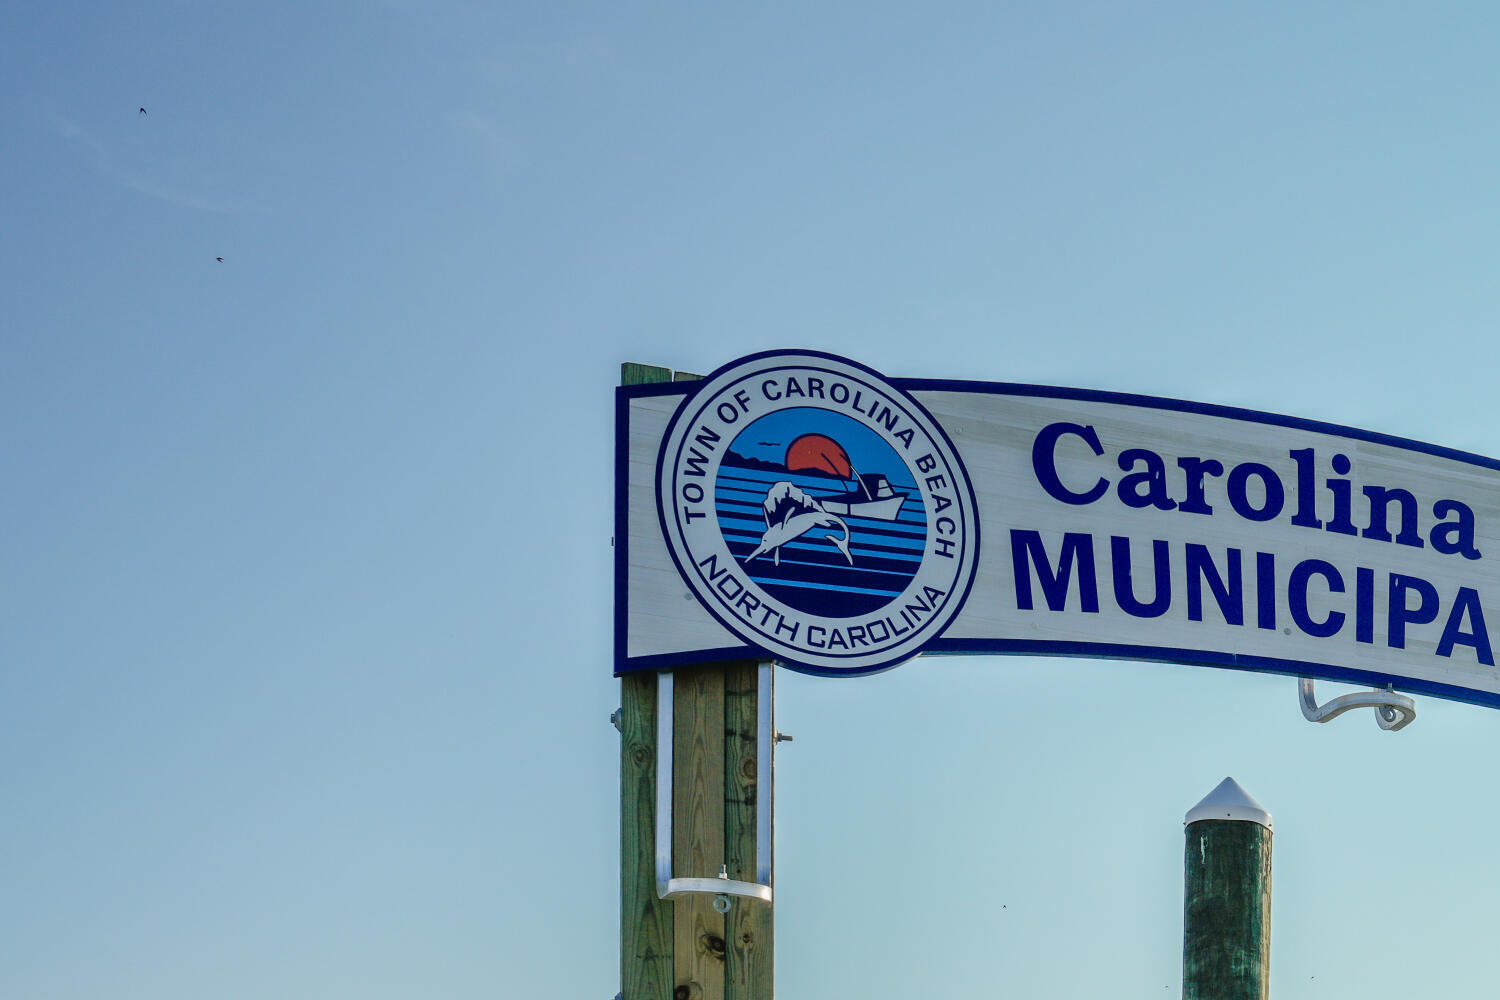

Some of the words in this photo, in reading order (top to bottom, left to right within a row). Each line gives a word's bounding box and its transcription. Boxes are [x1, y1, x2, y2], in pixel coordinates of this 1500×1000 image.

[682, 425, 721, 525] TOWN
[716, 389, 753, 425] OF
[761, 376, 915, 451] CAROLINA
[914, 452, 957, 560] BEACH
[1031, 421, 1483, 561] Carolina
[699, 553, 800, 641] NORTH
[806, 584, 947, 650] CAROLINA
